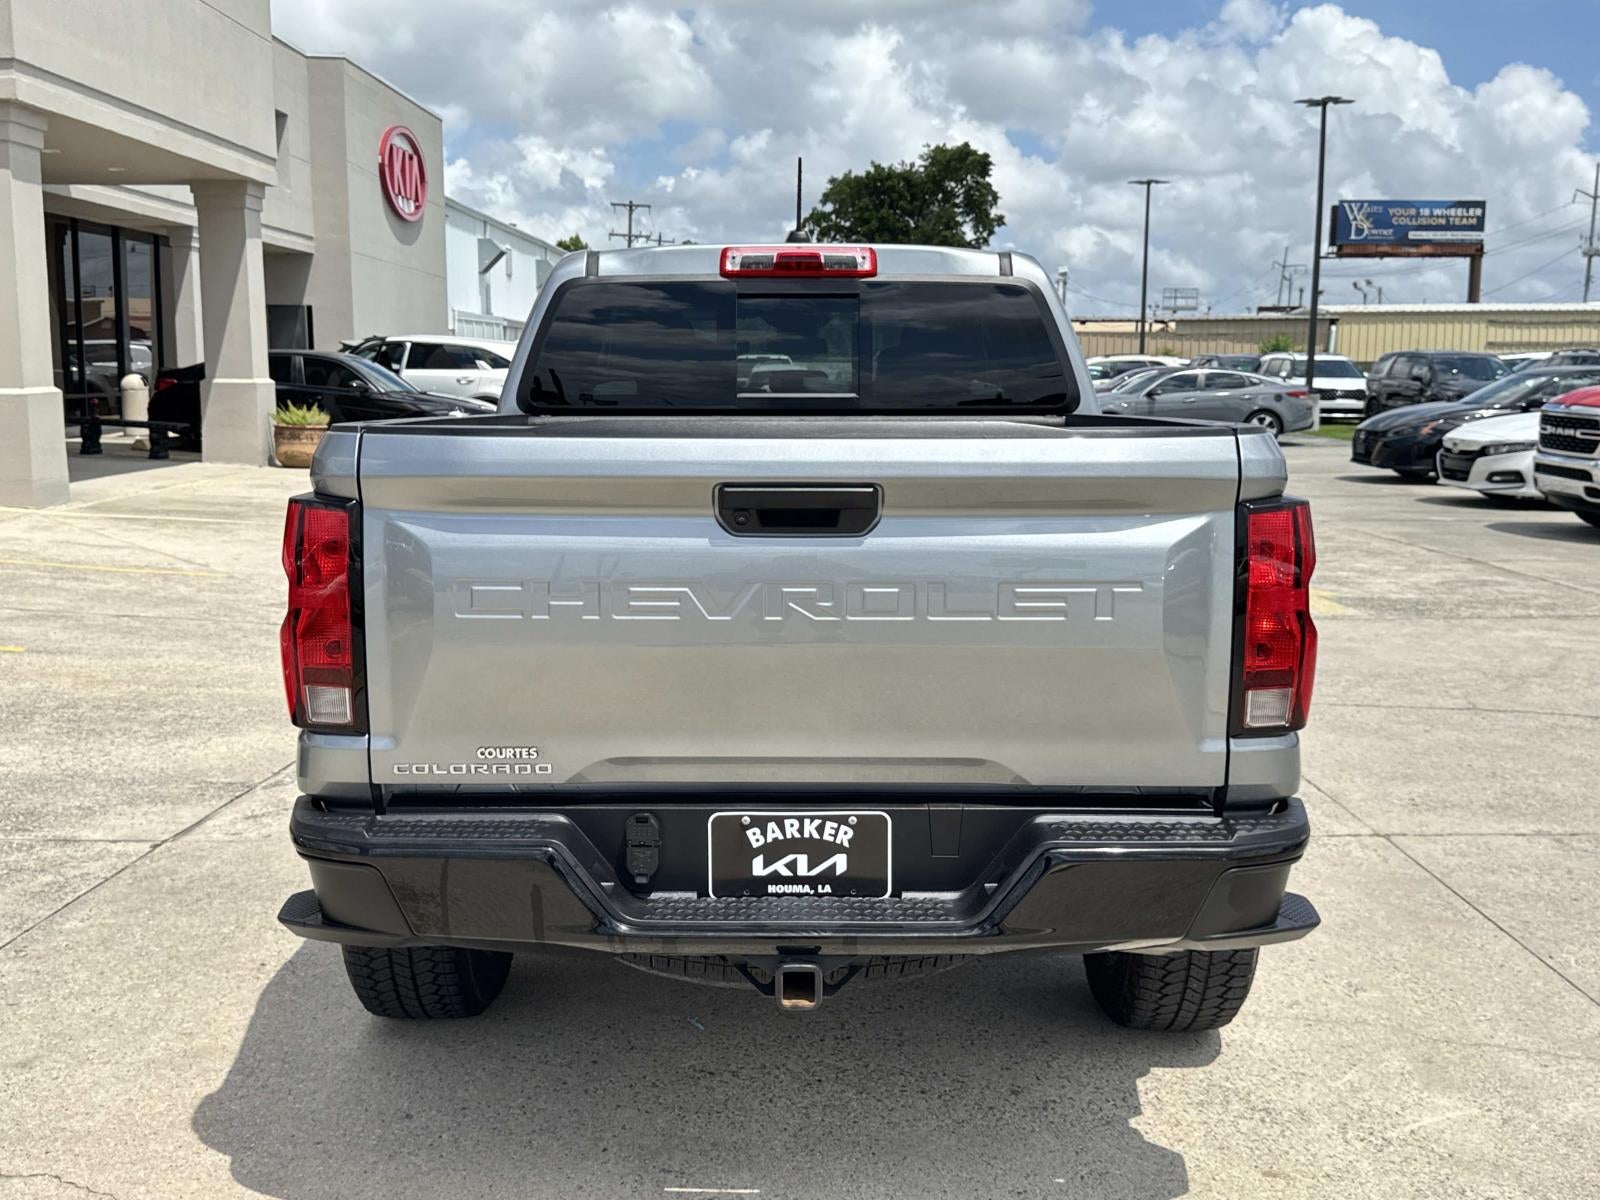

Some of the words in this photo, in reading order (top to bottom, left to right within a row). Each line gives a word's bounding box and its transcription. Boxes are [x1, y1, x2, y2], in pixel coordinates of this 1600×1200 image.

[389, 143, 422, 207] KIA
[1388, 207, 1416, 217] YOUR
[1420, 207, 1430, 217] 18
[1432, 207, 1482, 217] WHEELER
[1391, 216, 1446, 226] COLLISION
[1449, 216, 1478, 226] TEAM
[1551, 426, 1575, 437] RAM
[453, 578, 1144, 622] CHEVROLET
[476, 747, 538, 759] COURTES
[393, 763, 553, 775] COLORADO
[745, 818, 855, 849] BARKER
[752, 853, 848, 877] KIA
[767, 884, 815, 895] HOUMA,
[817, 884, 832, 894] LA
